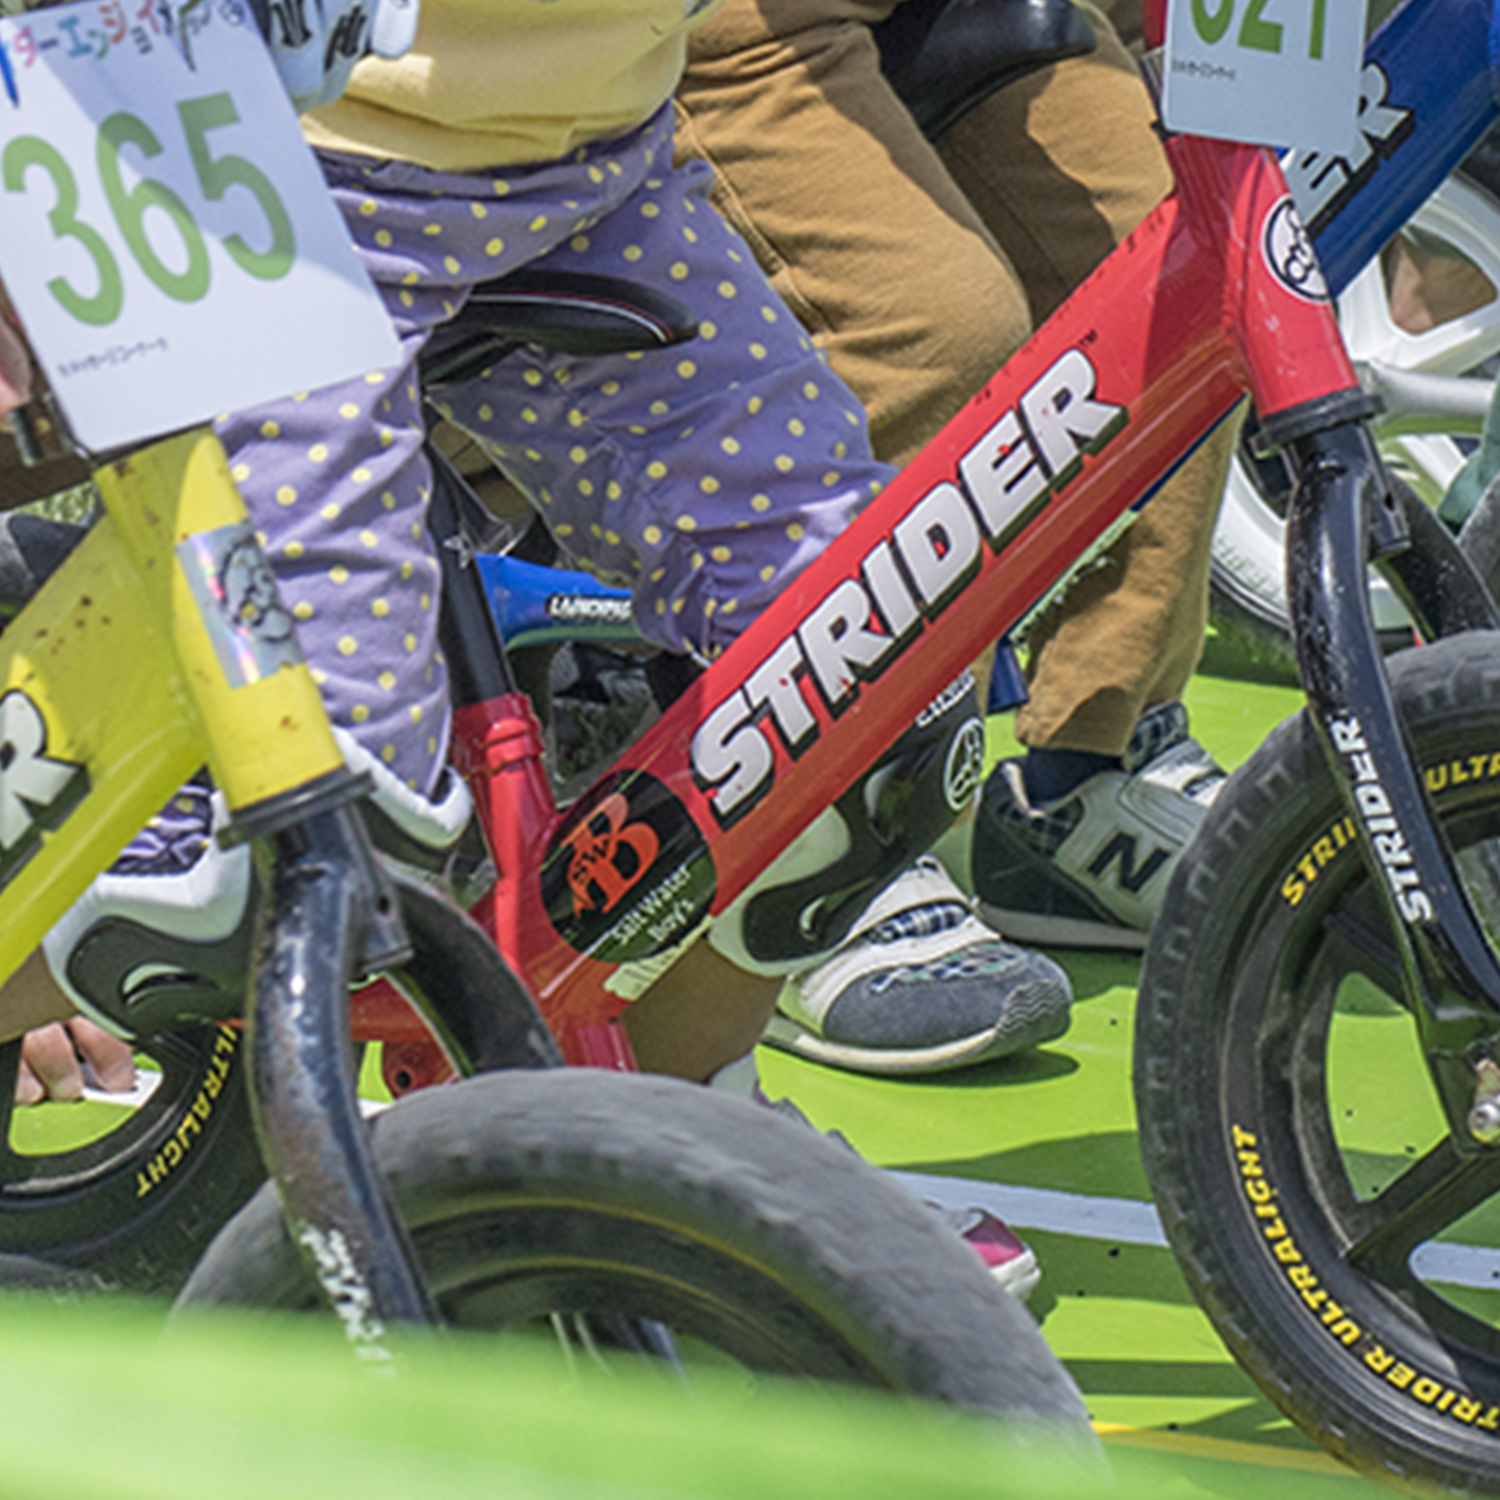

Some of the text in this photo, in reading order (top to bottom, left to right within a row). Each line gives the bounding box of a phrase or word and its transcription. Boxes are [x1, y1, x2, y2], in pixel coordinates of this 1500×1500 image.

[1, 90, 296, 328] 365
[690, 347, 1127, 826] STRIDER
[1088, 828, 1170, 894] N
[1330, 713, 1434, 925] STRIDER
[1231, 1123, 1362, 1347] ULTRALIGHT
